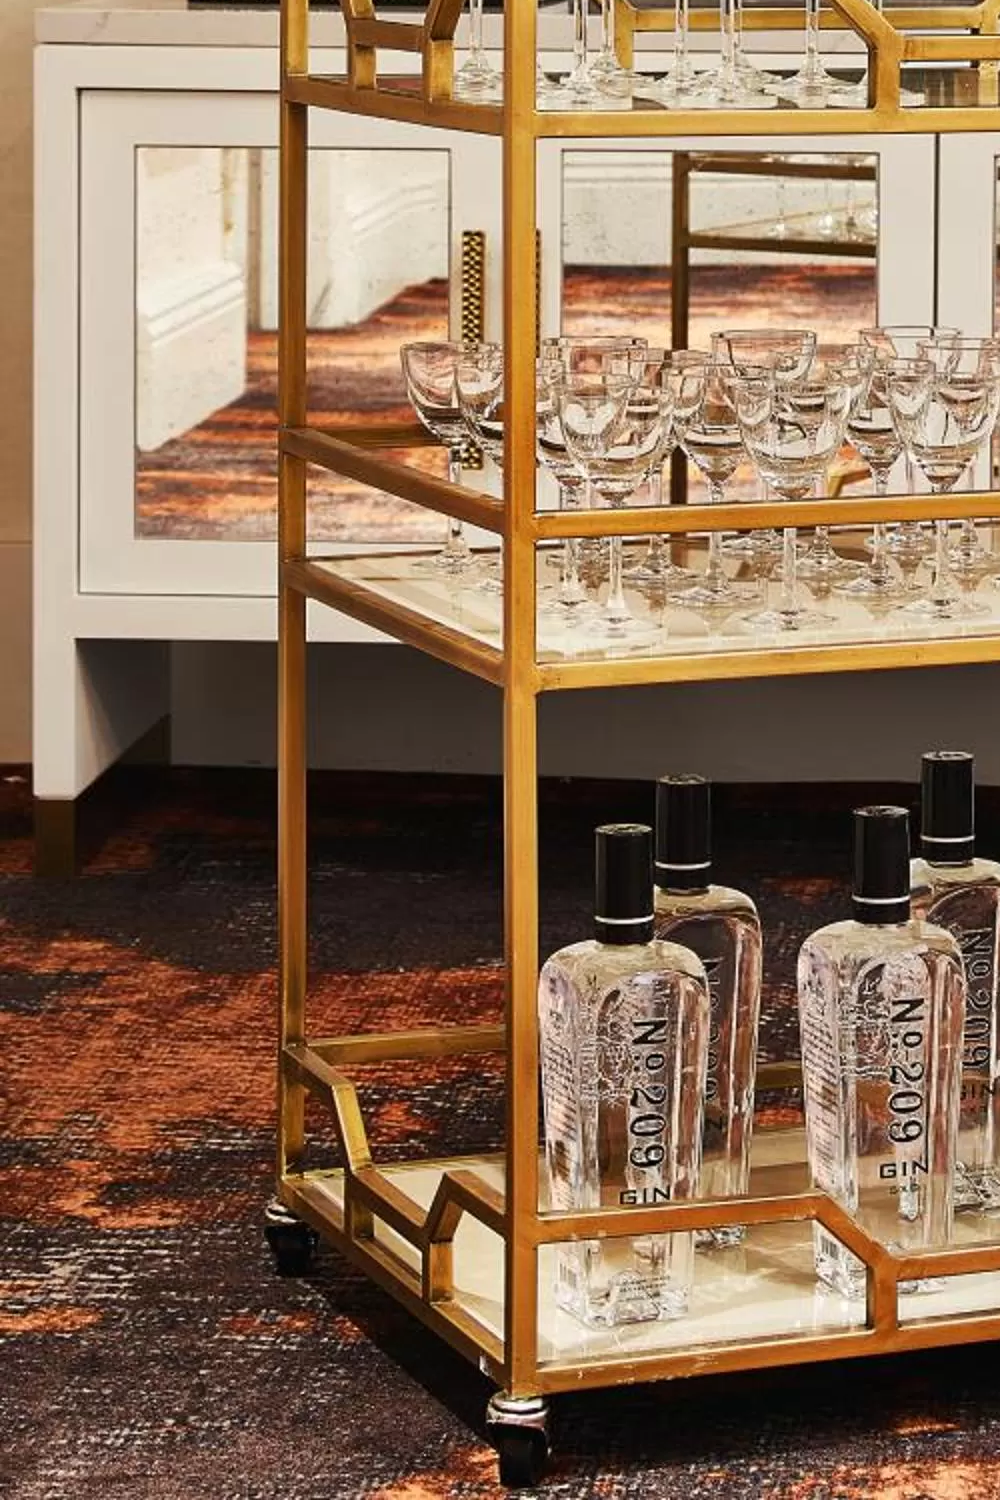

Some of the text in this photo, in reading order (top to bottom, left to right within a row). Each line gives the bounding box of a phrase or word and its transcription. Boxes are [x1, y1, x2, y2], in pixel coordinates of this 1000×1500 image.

[630, 1084, 667, 1170] 209
[888, 1062, 925, 1144] 209
[879, 1159, 929, 1179] GIN
[619, 1185, 672, 1206] GIN
